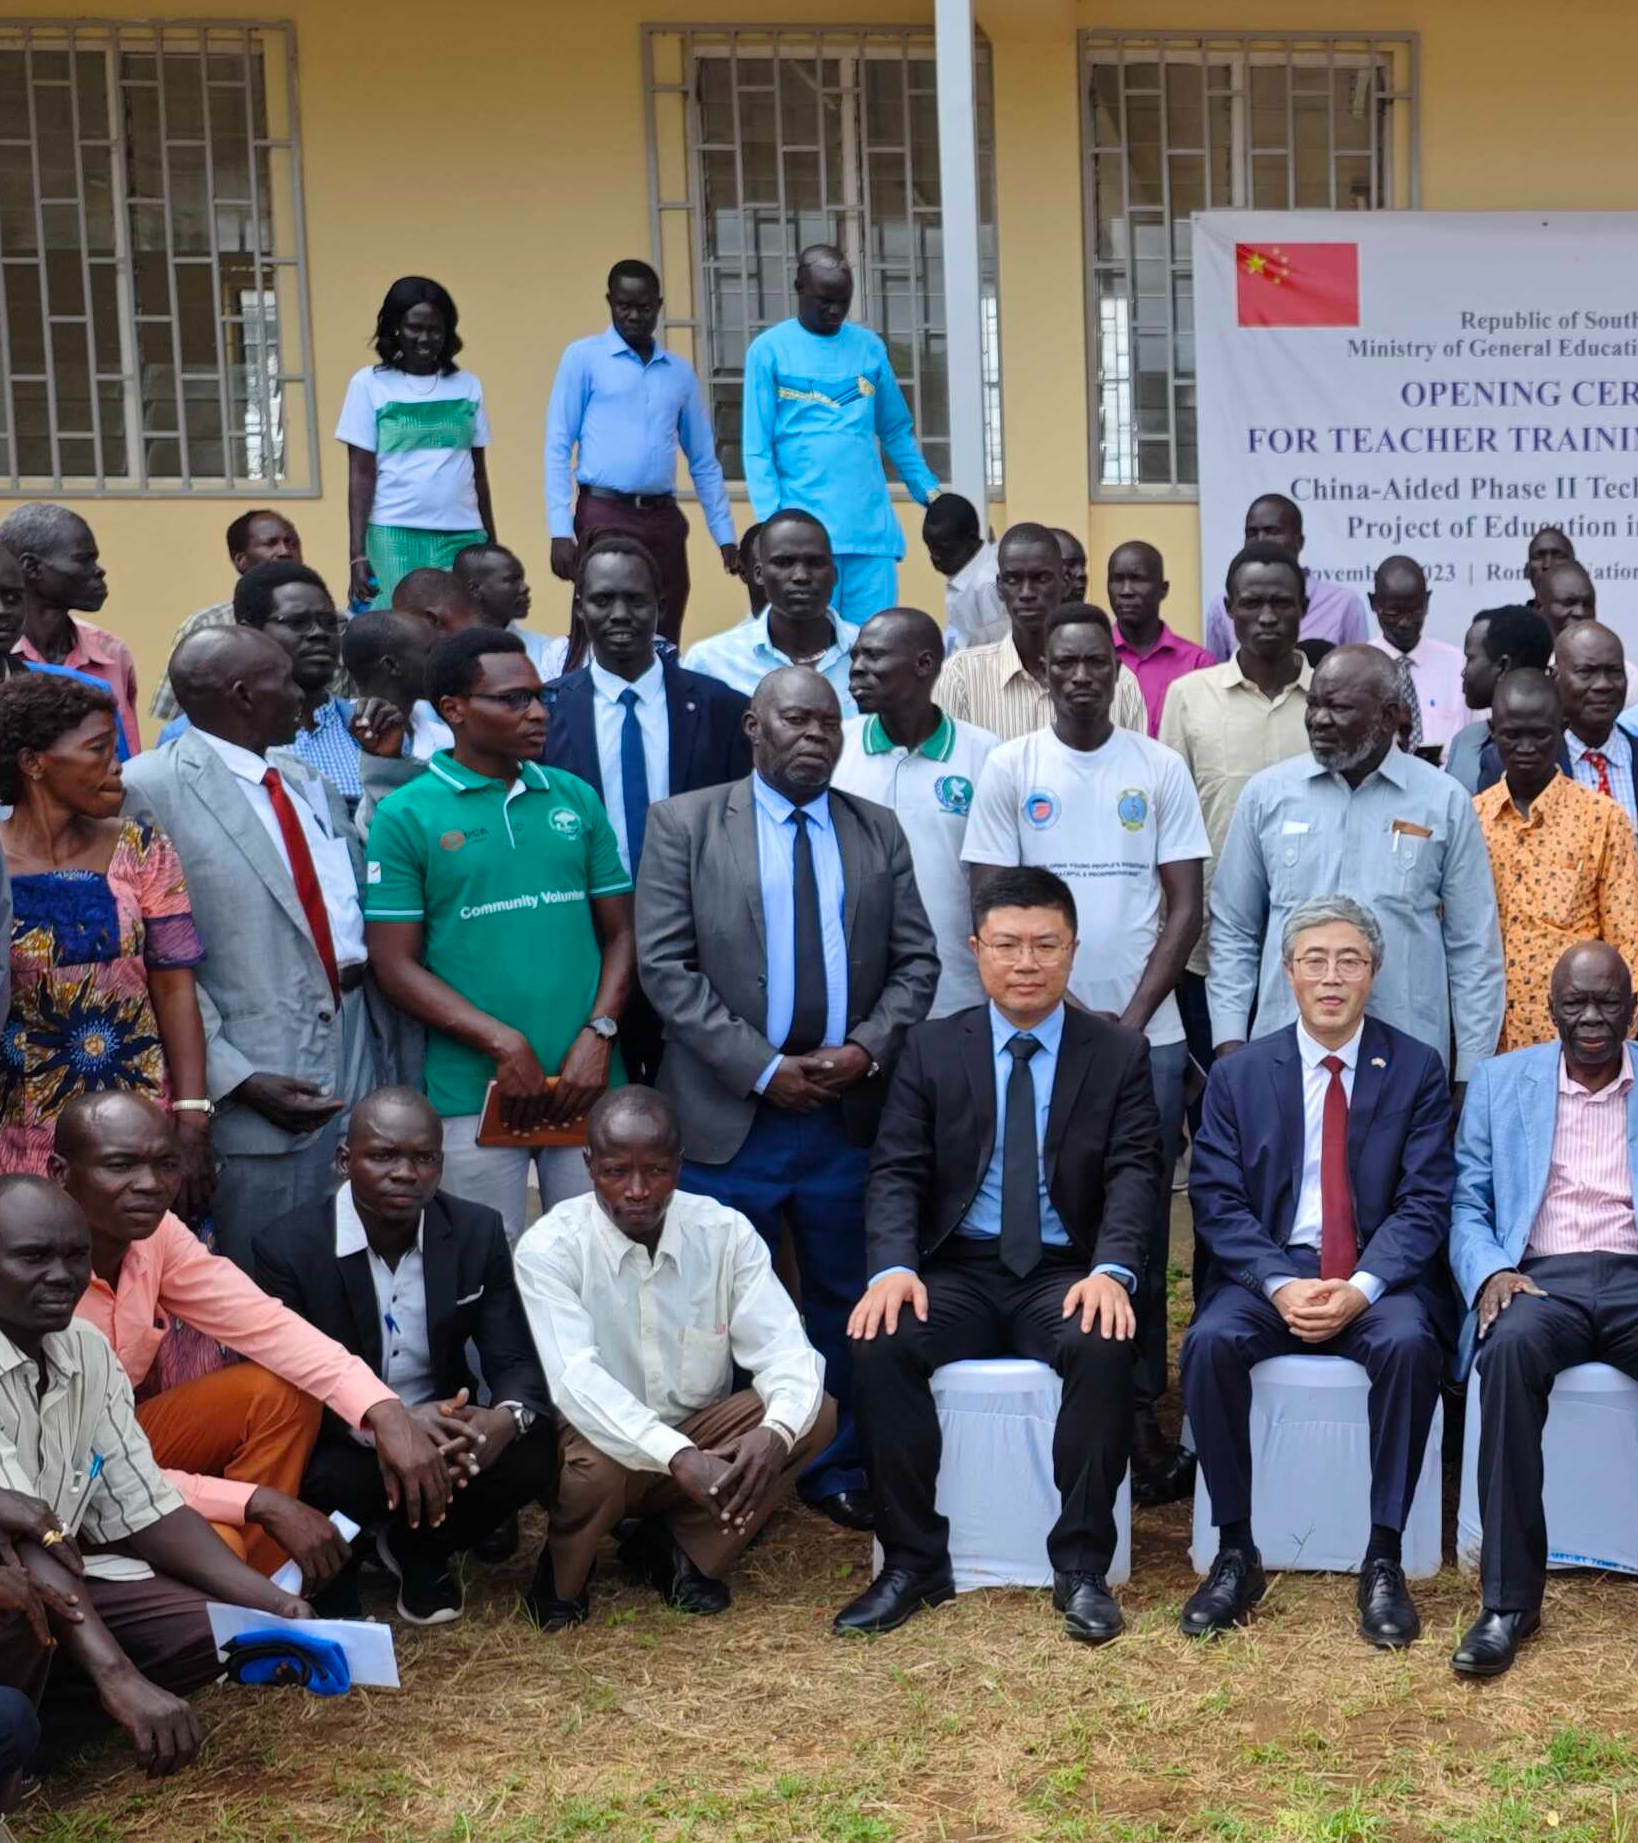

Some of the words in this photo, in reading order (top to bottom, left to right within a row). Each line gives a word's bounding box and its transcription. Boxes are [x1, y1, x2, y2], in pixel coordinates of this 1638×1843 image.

[1460, 310, 1551, 334] Republic
[1558, 311, 1580, 329] of
[1347, 338, 1436, 362] Ministry
[1443, 339, 1467, 357] of
[1469, 339, 1551, 357] General
[1400, 380, 1561, 407] OPENING
[1247, 428, 1319, 454] FOR
[1328, 427, 1498, 453] TEACHER
[1290, 477, 1461, 502] China-Aided
[1470, 477, 1546, 500] Phase
[1556, 476, 1578, 499] II
[1347, 514, 1441, 545] Project
[1449, 514, 1478, 538] of
[460, 895, 538, 919] Community
